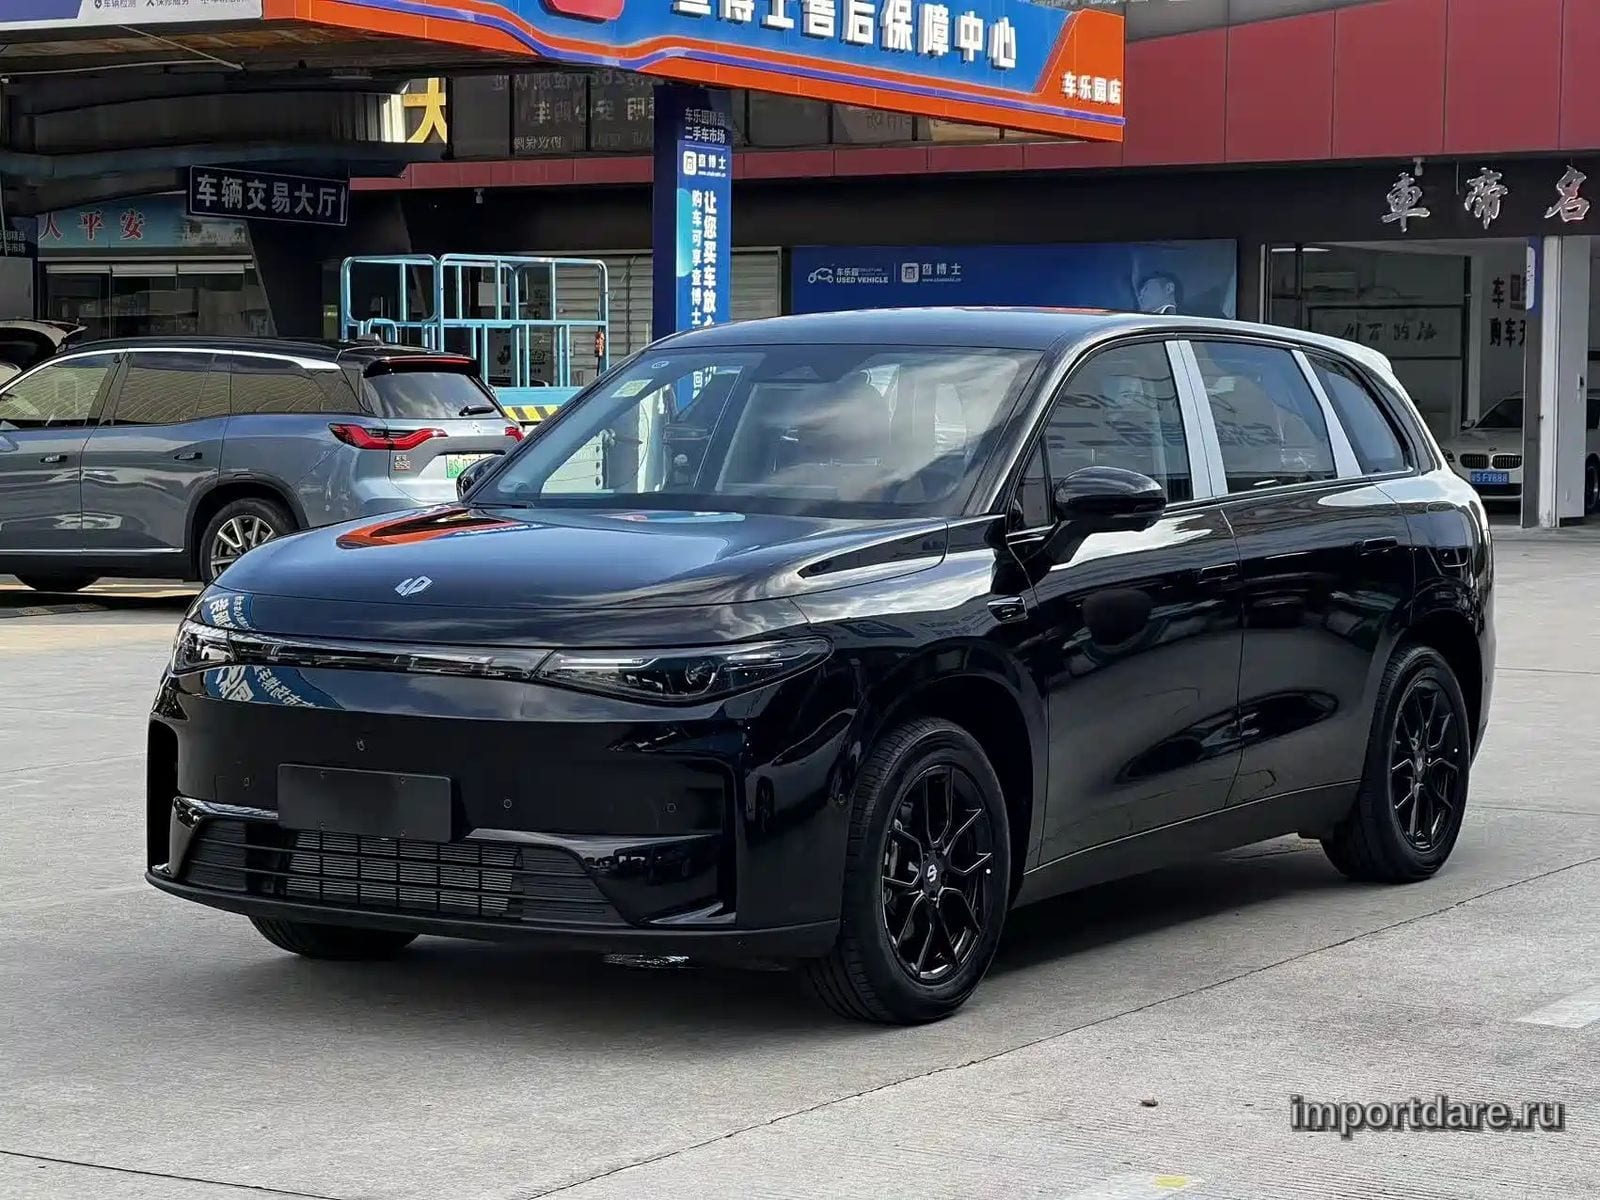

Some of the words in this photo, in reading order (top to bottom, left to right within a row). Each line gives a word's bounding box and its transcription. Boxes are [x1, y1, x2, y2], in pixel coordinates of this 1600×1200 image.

[673, 0, 1016, 69] 士售后保障中心
[1062, 71, 1121, 104] 车乐园店
[685, 126, 726, 144] 二手车市场
[196, 173, 338, 217] 车辆交易大厅
